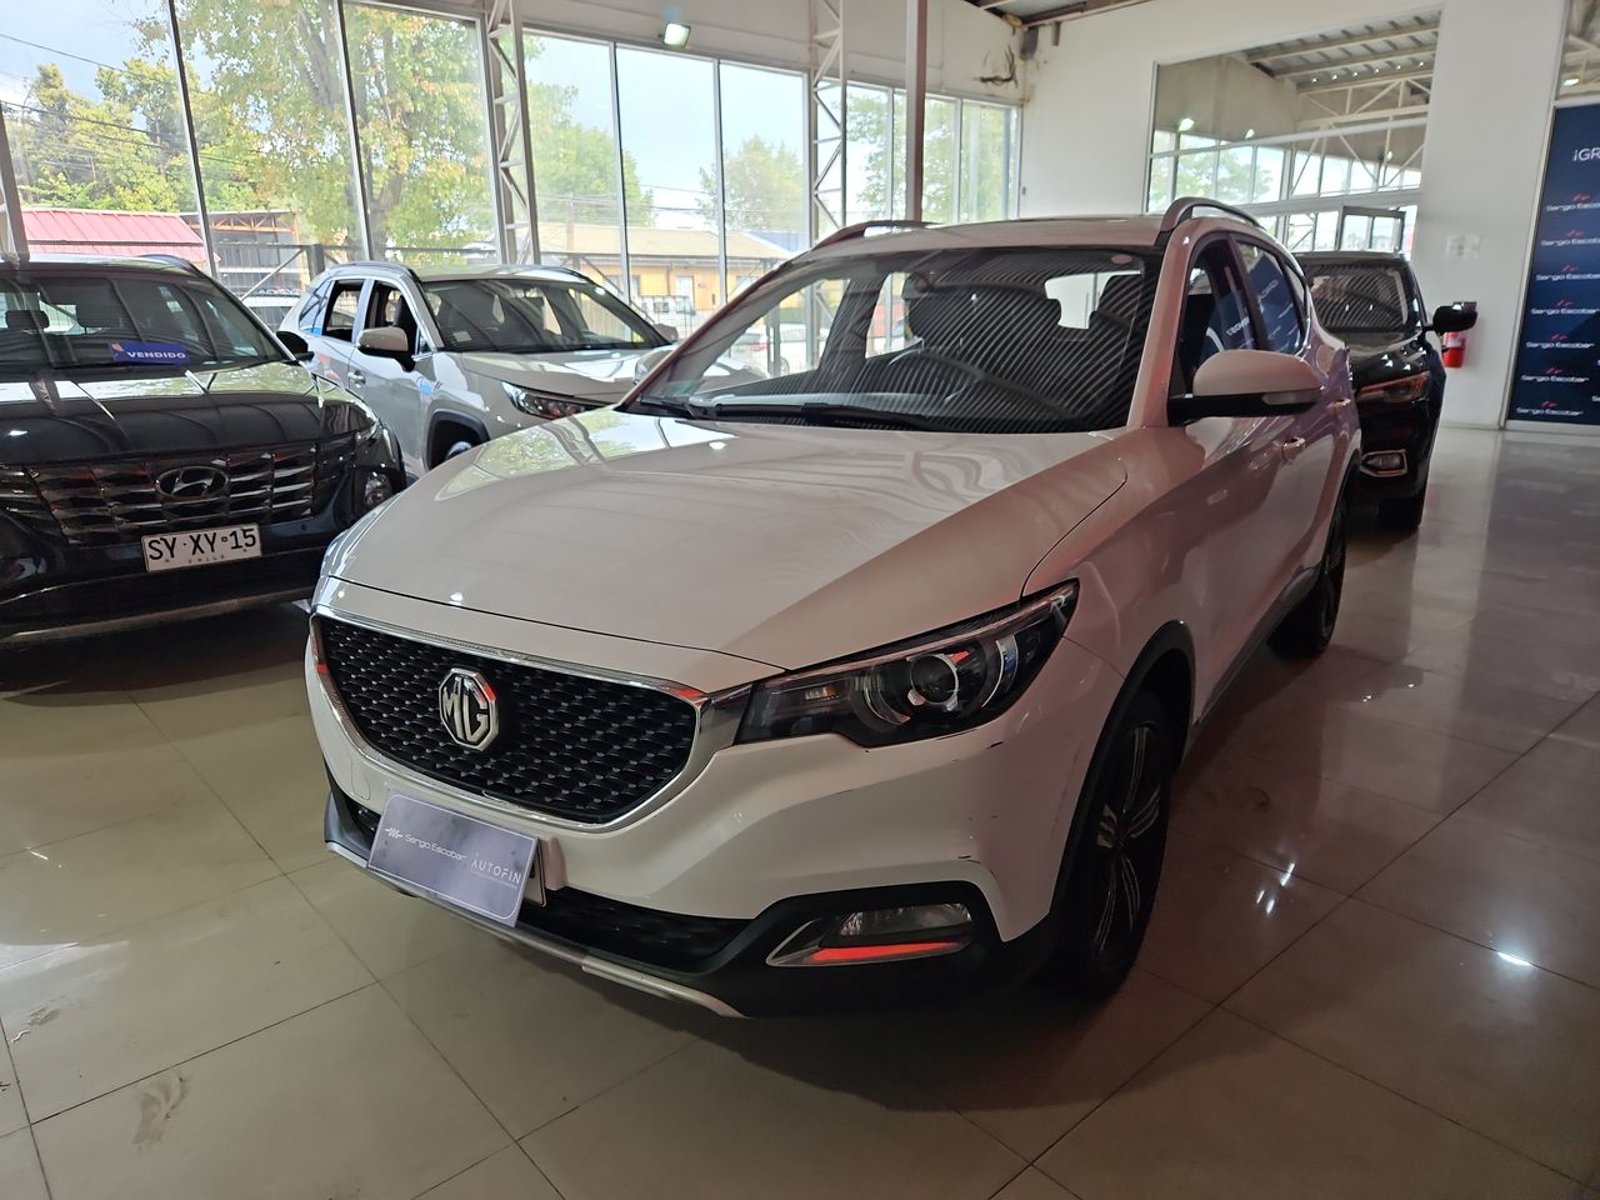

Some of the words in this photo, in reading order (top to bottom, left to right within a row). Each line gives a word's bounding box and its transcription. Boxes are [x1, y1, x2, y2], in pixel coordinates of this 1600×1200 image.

[127, 351, 186, 359] VENDIDO
[442, 676, 489, 743] MG
[471, 858, 521, 885] AUTOFIN
